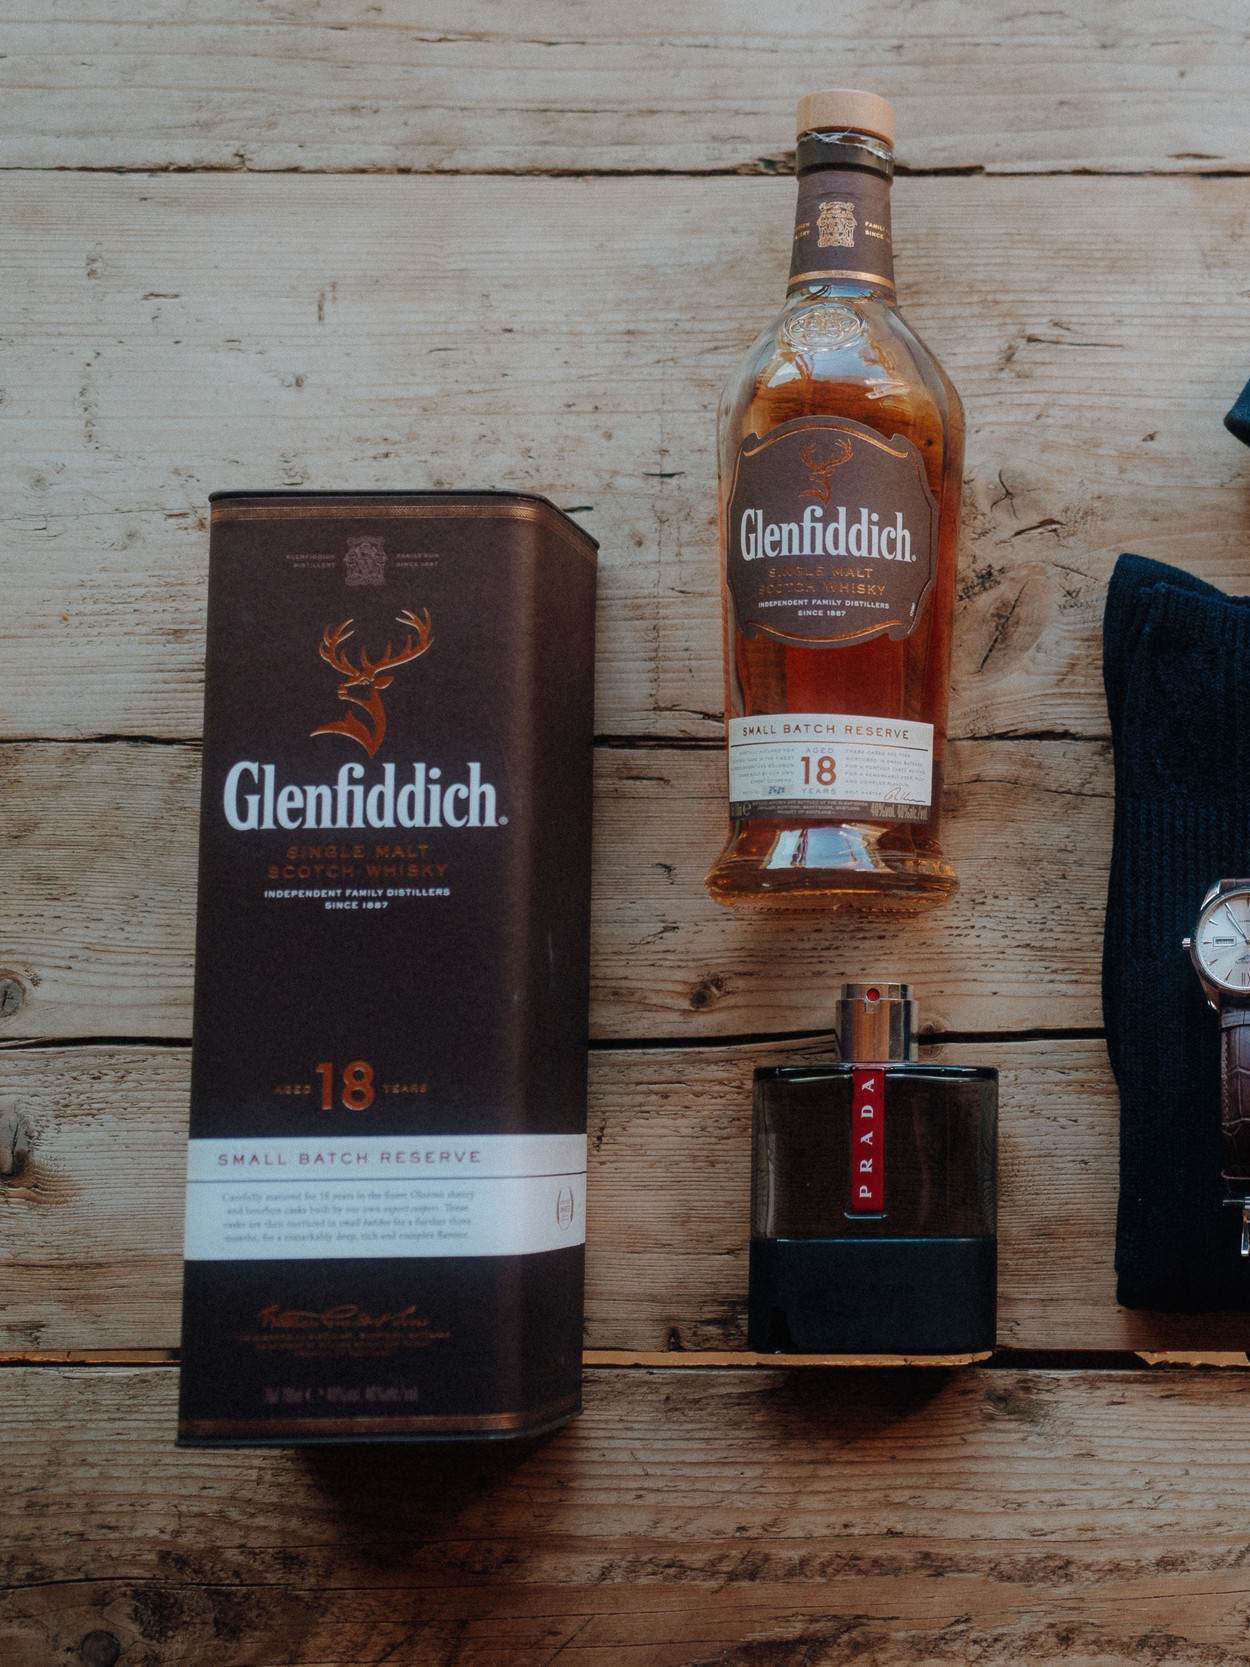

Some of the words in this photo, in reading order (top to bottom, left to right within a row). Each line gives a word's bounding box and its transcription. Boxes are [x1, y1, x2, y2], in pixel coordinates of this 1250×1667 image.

[864, 230, 884, 240] SINCE
[740, 504, 912, 563] Glenfiddich
[768, 566, 824, 578] SINGLE
[832, 566, 874, 579] MALT
[757, 583, 817, 595] SCOTCH
[825, 583, 887, 596] WHISKY
[758, 599, 809, 609] INDEPENDENT
[845, 600, 890, 610] DISTILLERS
[743, 725, 776, 737] SMALL
[783, 724, 836, 734] BATCH
[844, 725, 910, 740] RESERVE
[800, 756, 837, 786] 18
[223, 760, 498, 831] Glenfiddich
[286, 845, 364, 860] SINGLE
[375, 845, 430, 859] MALT
[267, 864, 356, 880] SCOTCH
[366, 863, 448, 879] WHISKY
[264, 890, 342, 899] INDEPENDENT
[346, 889, 384, 898] FAMILY
[386, 888, 451, 897] DISTILLERS
[324, 901, 360, 910] SINCE
[274, 1084, 313, 1096] AGED
[315, 1058, 376, 1112] 18
[382, 1083, 429, 1094] YEARS
[859, 1077, 876, 1199] PRADA
[218, 1152, 288, 1167] SMALL
[298, 1152, 368, 1166] BATCH
[380, 1150, 483, 1164] RESERVE
